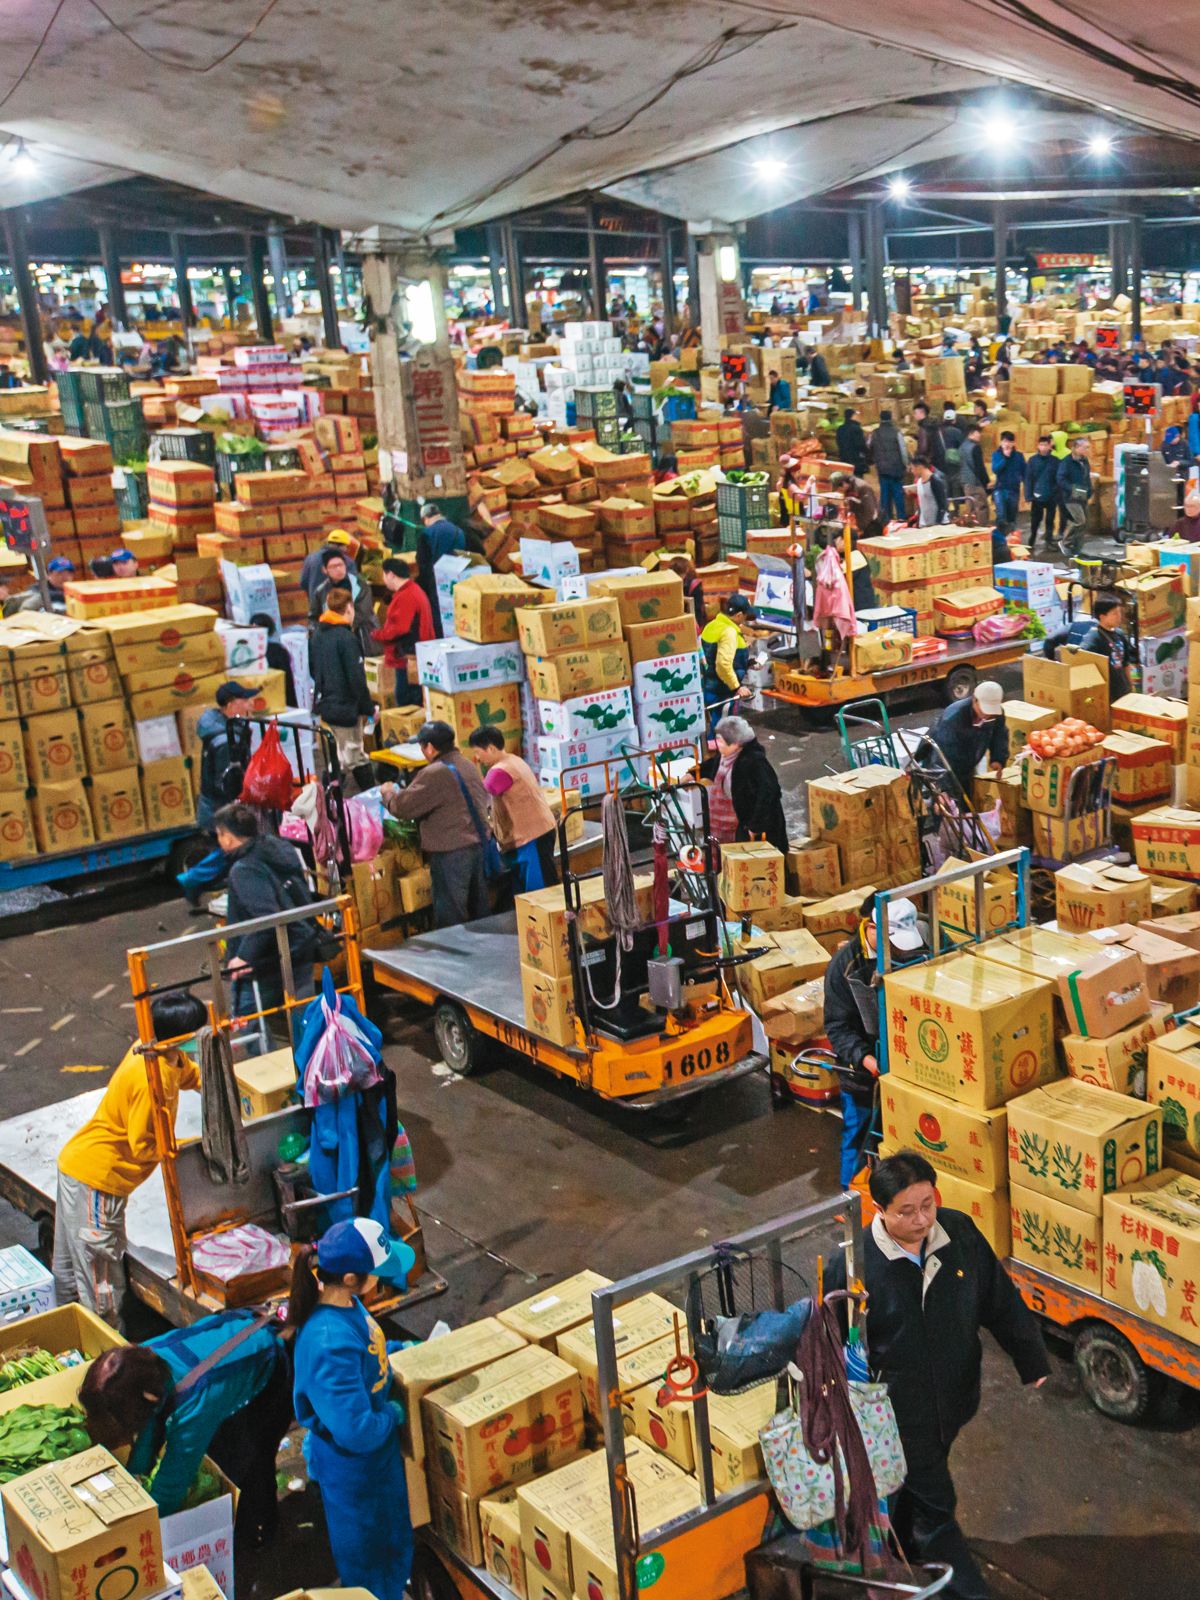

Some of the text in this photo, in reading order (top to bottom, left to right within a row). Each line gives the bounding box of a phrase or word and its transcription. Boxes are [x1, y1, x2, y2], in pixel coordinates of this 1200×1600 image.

[663, 1041, 731, 1083] 1608
[960, 1031, 978, 1082] 蔬菜
[1120, 1214, 1180, 1257] 杉林農會
[1180, 1279, 1199, 1328] 苦瓜
